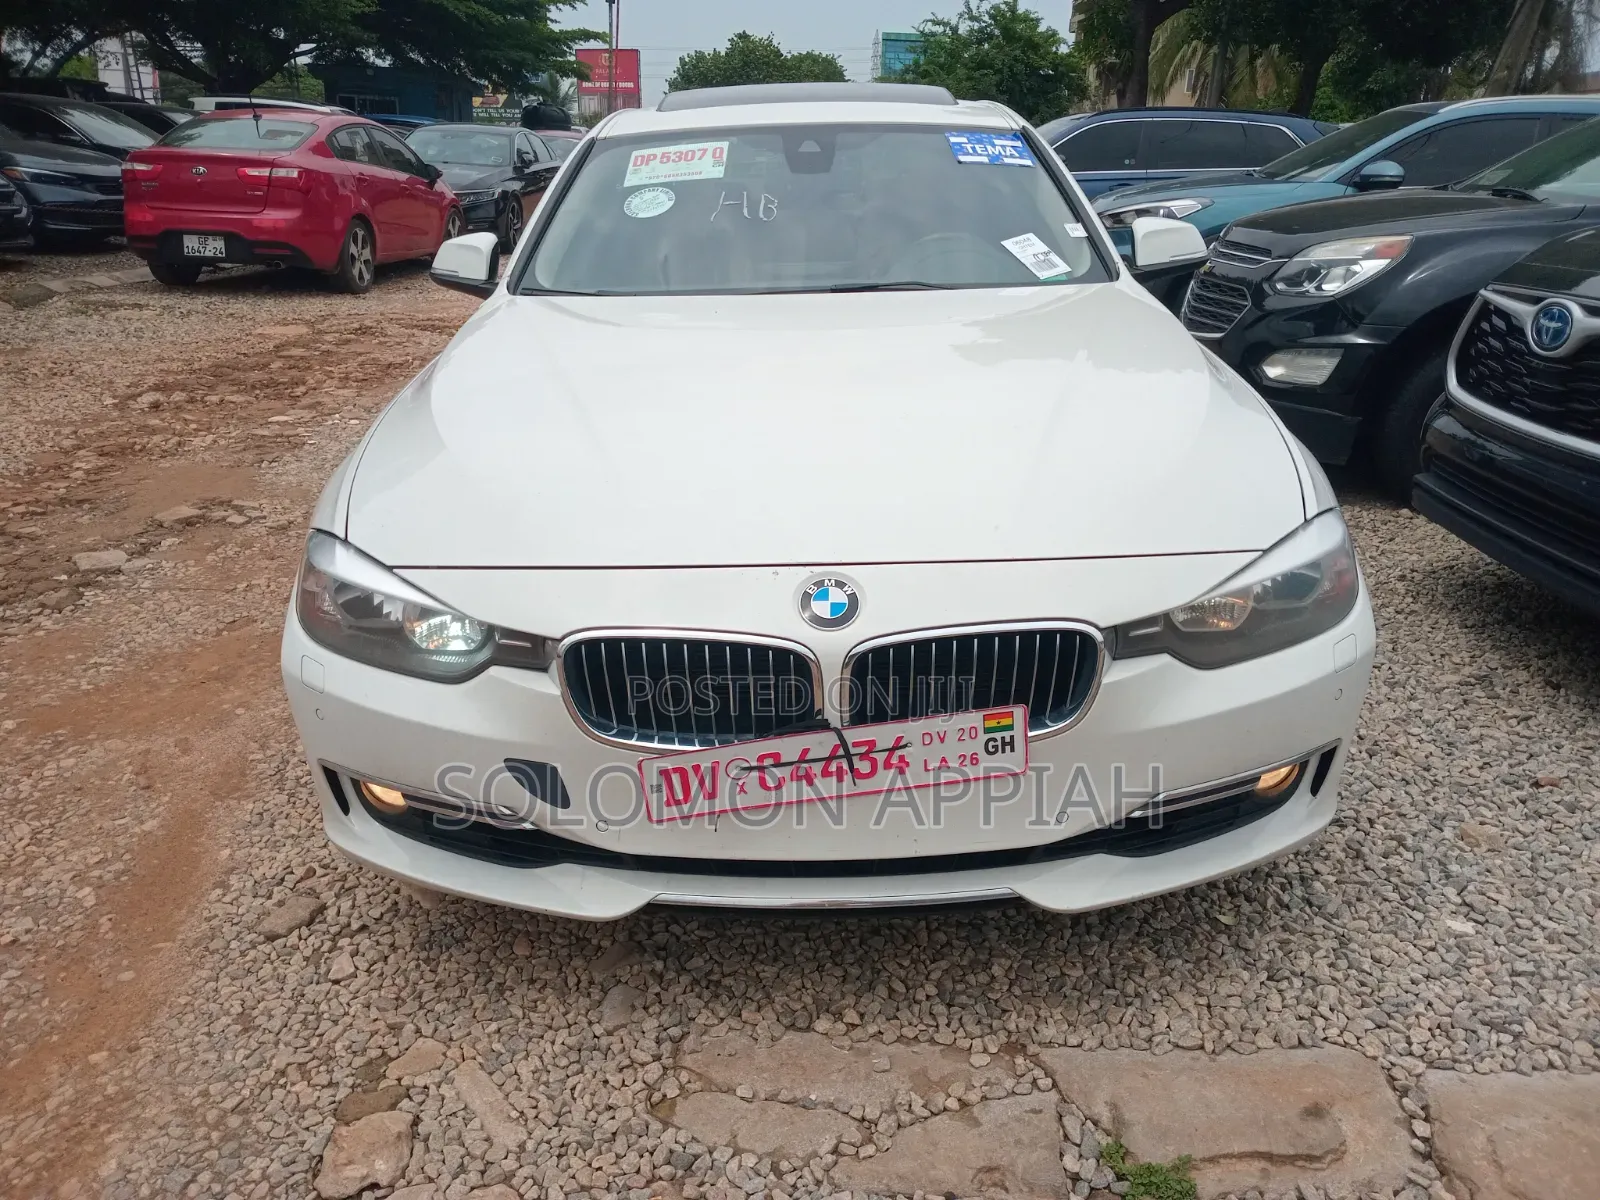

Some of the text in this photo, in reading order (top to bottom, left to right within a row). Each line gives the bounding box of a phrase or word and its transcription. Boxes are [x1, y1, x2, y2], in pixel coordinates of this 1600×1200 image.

[632, 153, 658, 168] DP
[659, 148, 708, 165] 5307
[962, 143, 1020, 158] TEMA
[632, 187, 660, 200] COMPANY
[198, 236, 210, 246] GE
[185, 245, 224, 256] 1647-24
[805, 579, 855, 595] BMW
[920, 725, 979, 746] DV 20
[983, 734, 1017, 757] GH
[922, 751, 981, 773] LA 26
[658, 759, 720, 808] DV
